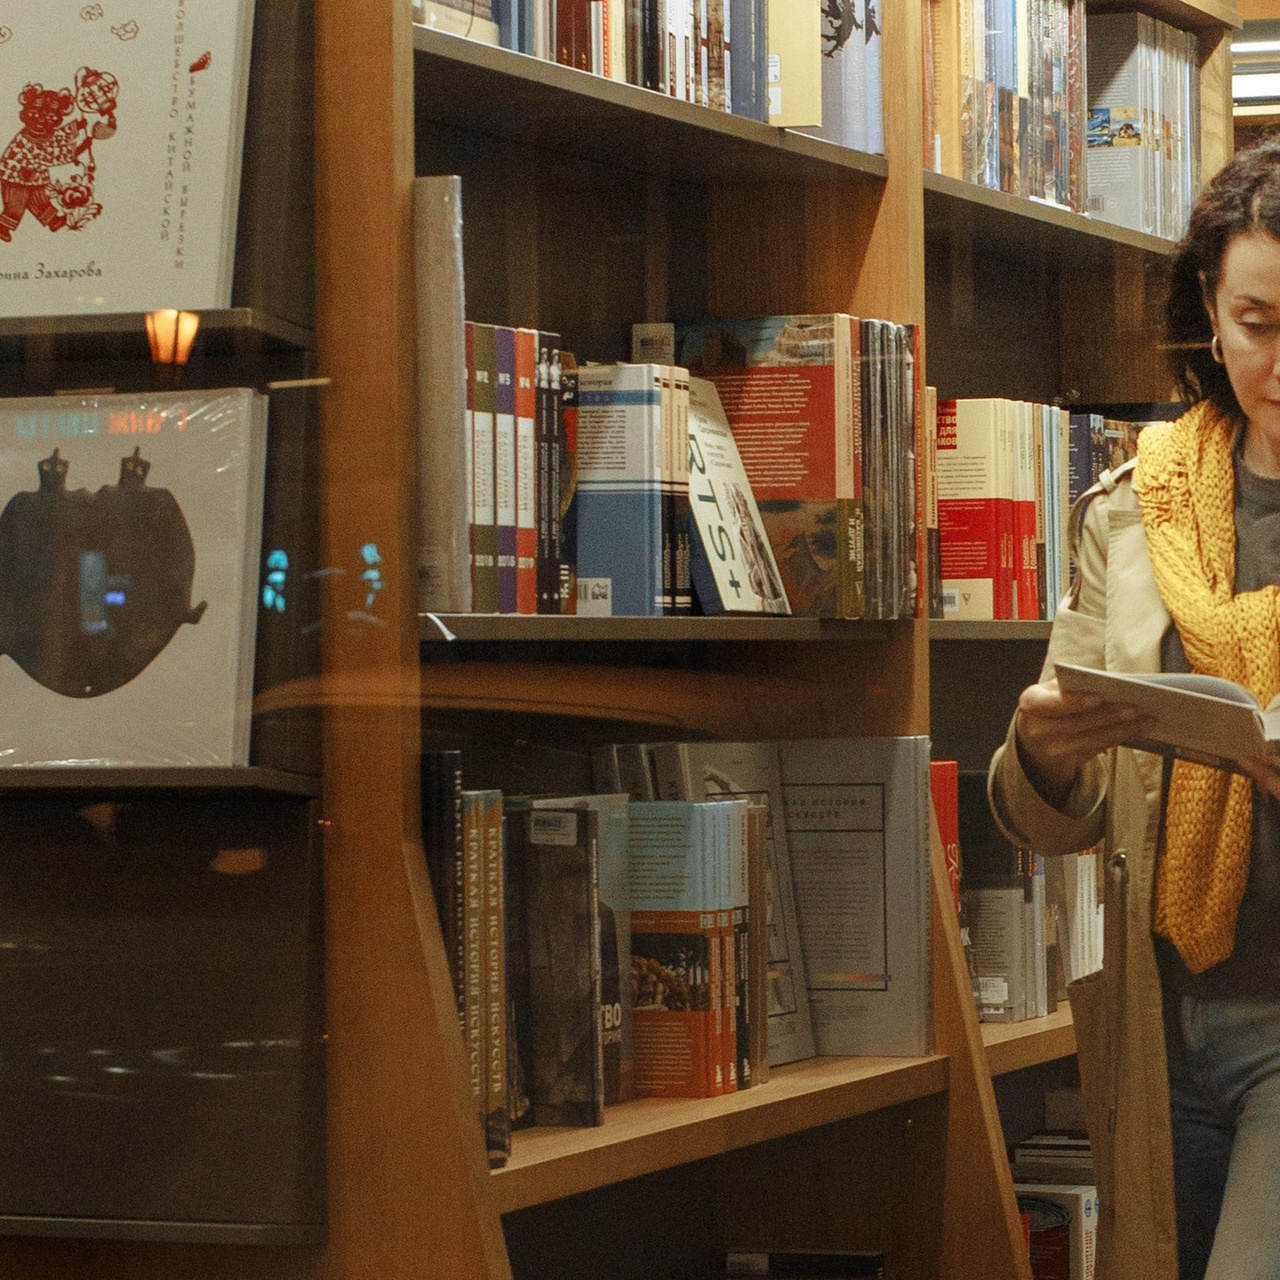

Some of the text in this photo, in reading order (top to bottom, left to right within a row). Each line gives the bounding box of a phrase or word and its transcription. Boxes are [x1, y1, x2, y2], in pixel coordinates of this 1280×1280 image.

[160, 131, 178, 240] КИТАЙСКОЙ
[174, 75, 196, 269] БУМАЖНОЙ ВЫРЕЗКИ
[34, 260, 103, 283] Захарова
[469, 829, 482, 1096] КРАТКАЯ ИСТОРИЯ ИСКУССТВ
[488, 827, 502, 1093] КРАТКАЯ ИСТОРИЯ ИСКУССТВ
